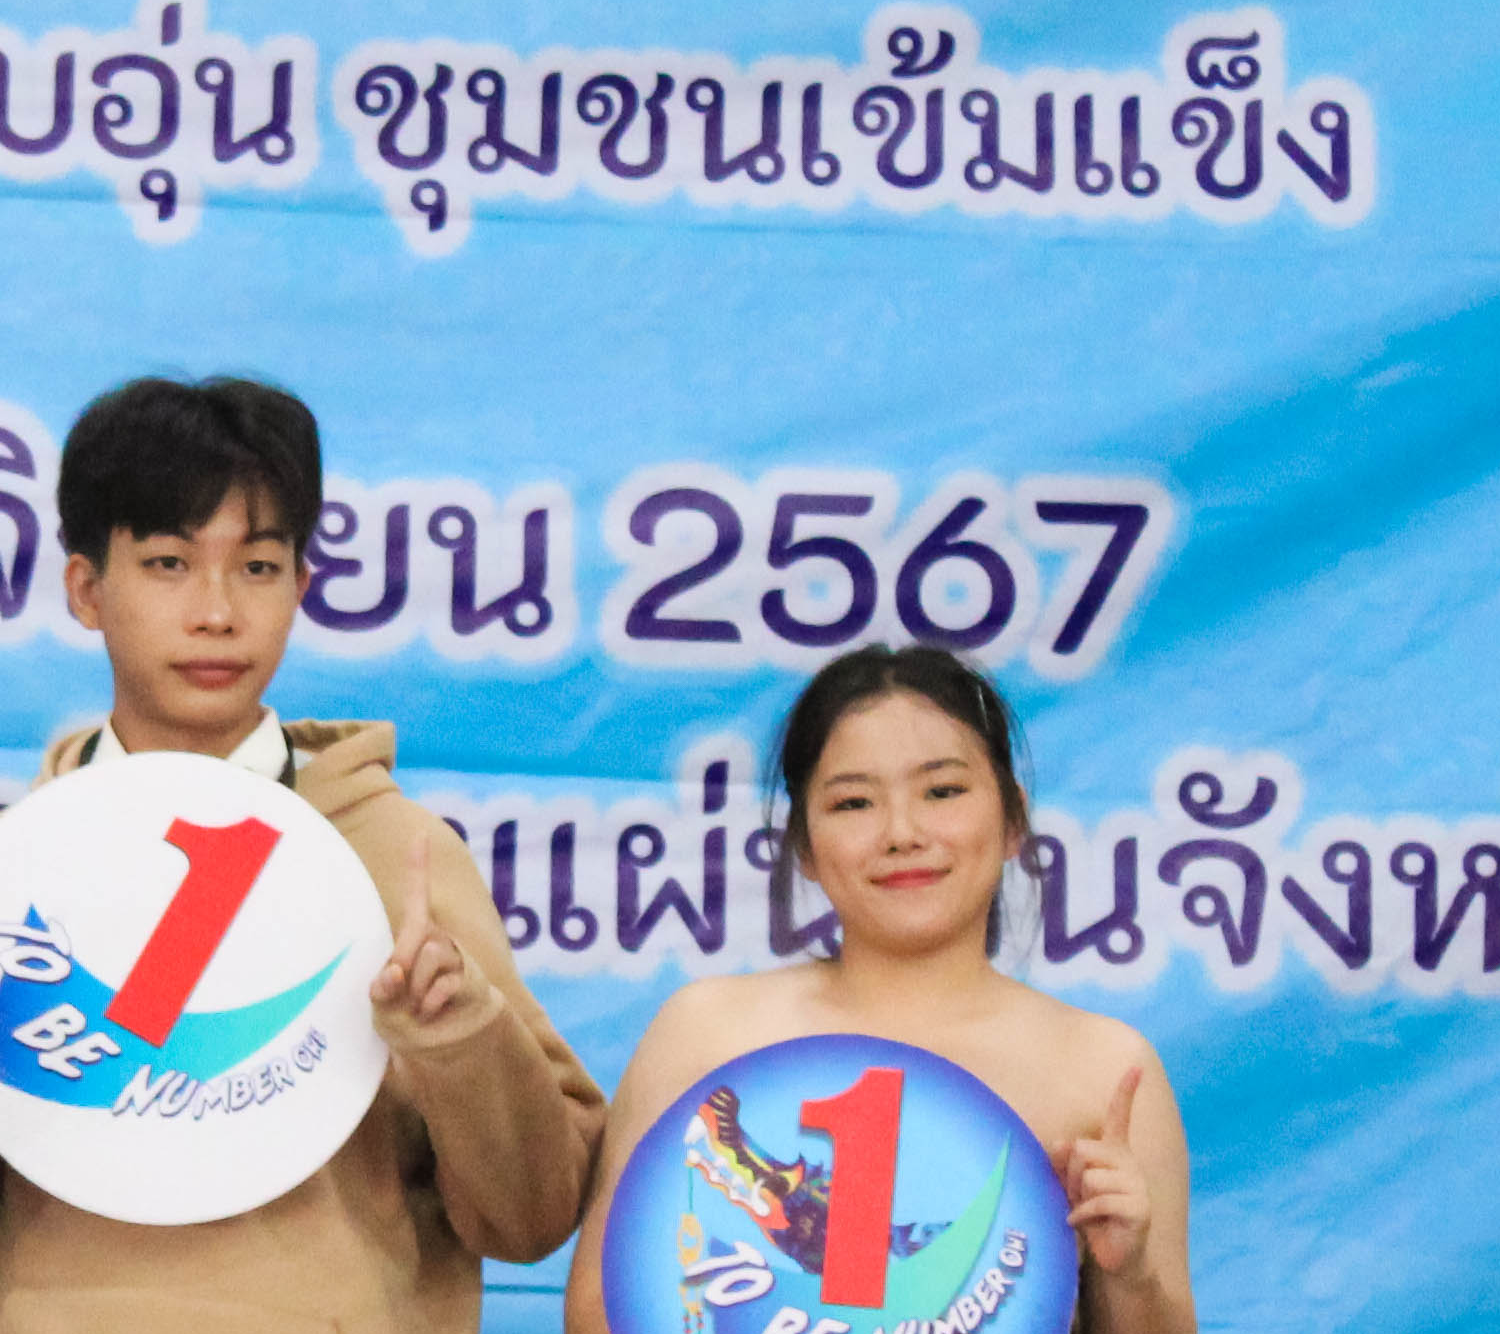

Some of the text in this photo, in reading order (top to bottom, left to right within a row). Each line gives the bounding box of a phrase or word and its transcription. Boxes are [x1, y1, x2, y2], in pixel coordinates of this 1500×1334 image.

[352, 27, 1352, 233] ชุมชนเข้มแข็ง
[622, 487, 1148, 651] 2567
[103, 816, 284, 1049] 1
[12, 1003, 121, 1079] BE
[112, 1065, 295, 1121] NUMBER
[683, 1240, 774, 1307] TO
[800, 1067, 904, 1308] 1
